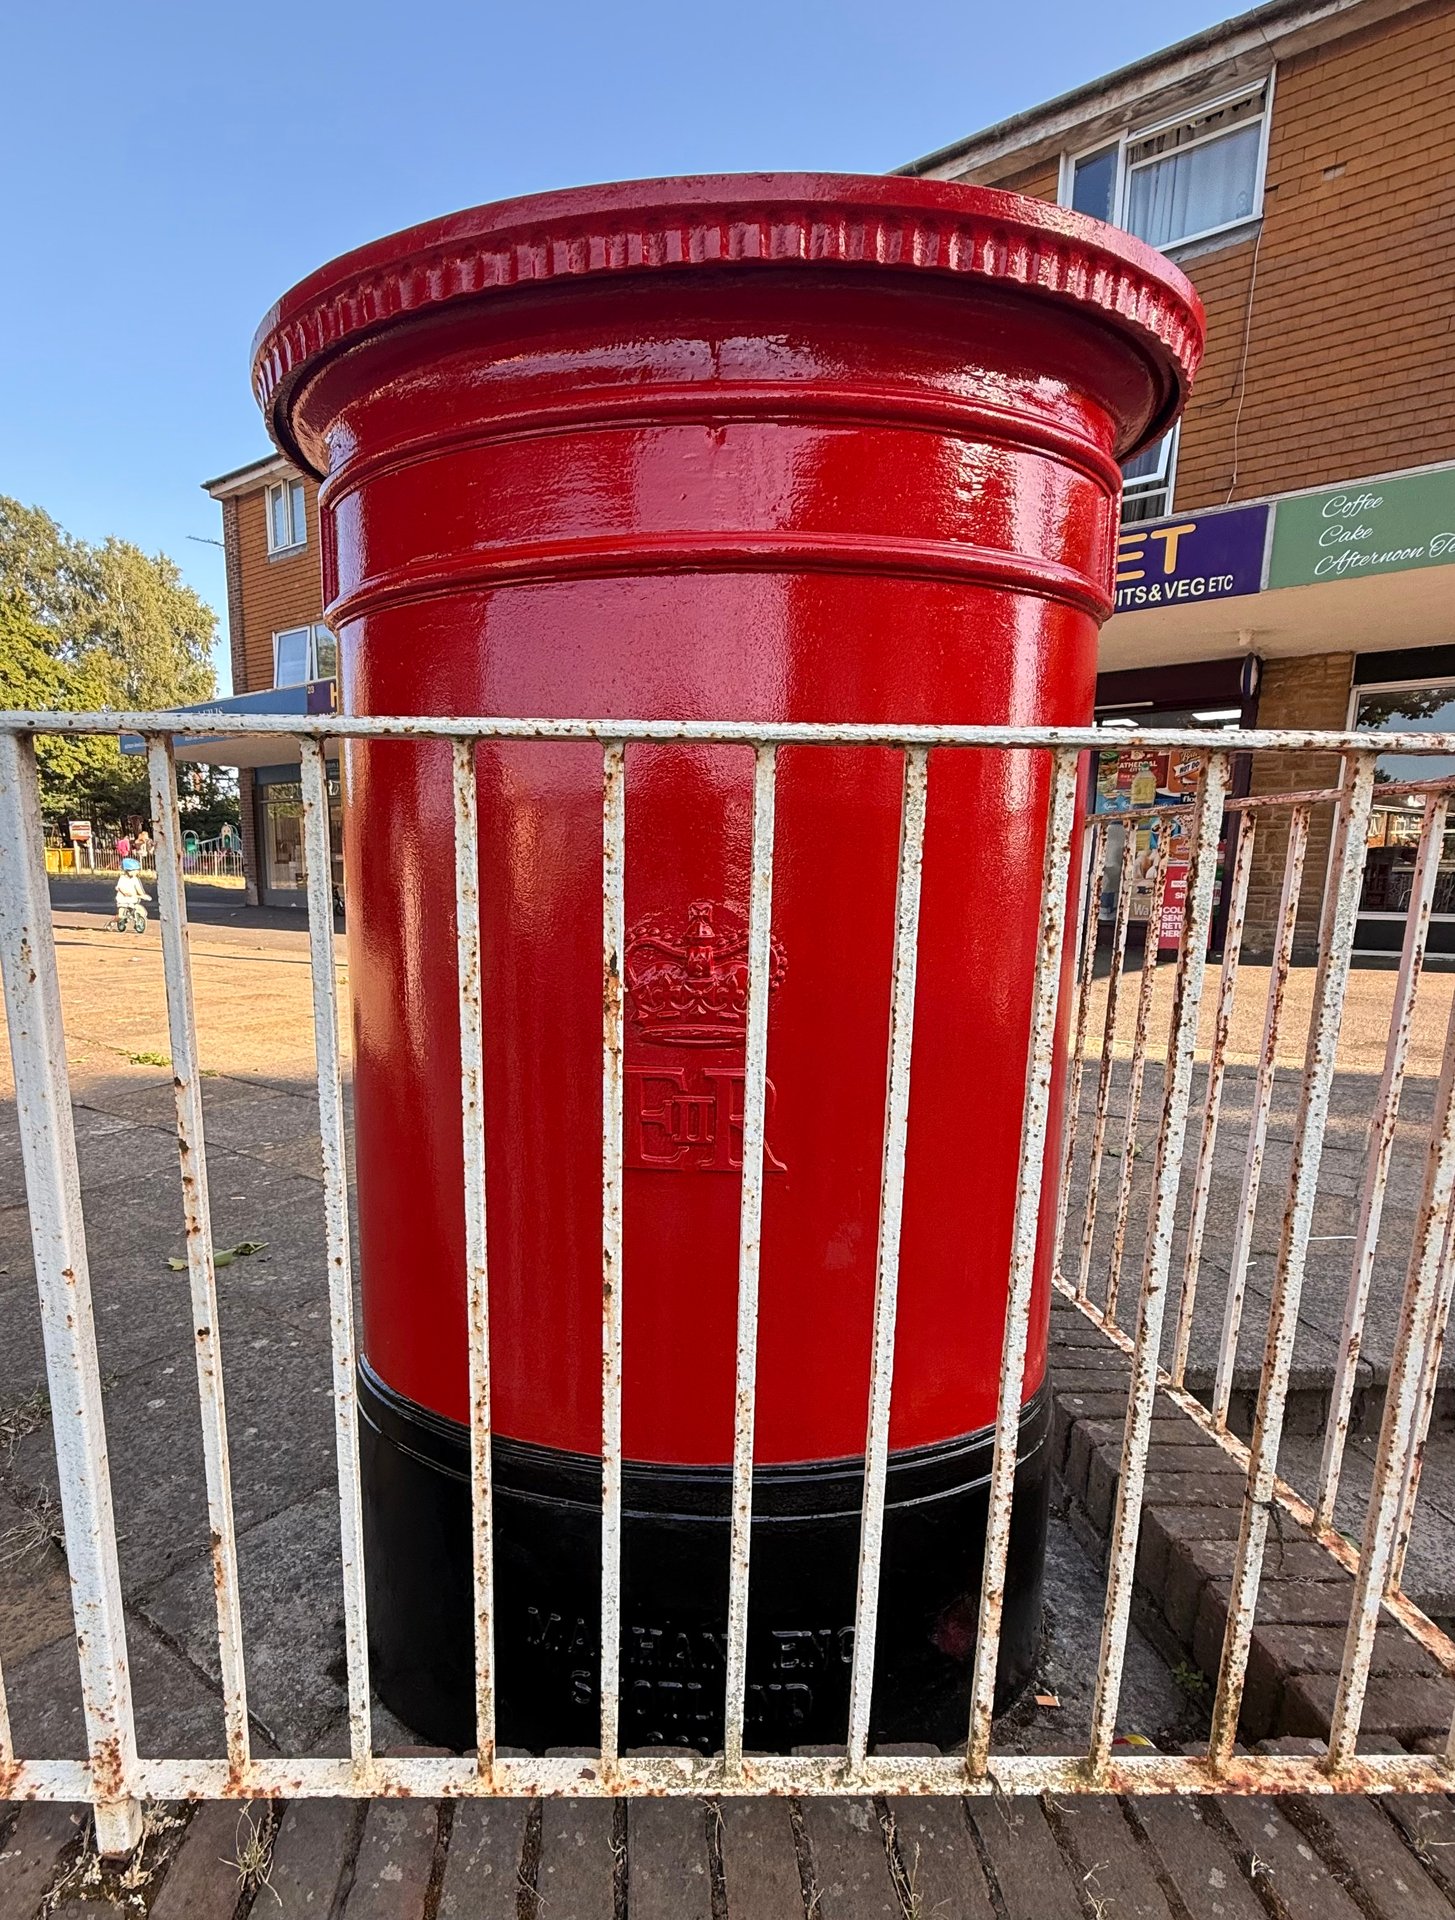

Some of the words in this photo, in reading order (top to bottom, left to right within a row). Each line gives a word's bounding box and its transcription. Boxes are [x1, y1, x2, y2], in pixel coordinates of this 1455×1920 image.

[1322, 493, 1384, 518] Coffee
[1319, 524, 1374, 547] Cake
[1314, 549, 1425, 575] Afternoon
[1428, 532, 1455, 558] Te
[1165, 577, 1205, 599] VEG
[1208, 575, 1234, 593] ETC
[1161, 930, 1180, 938] HER
